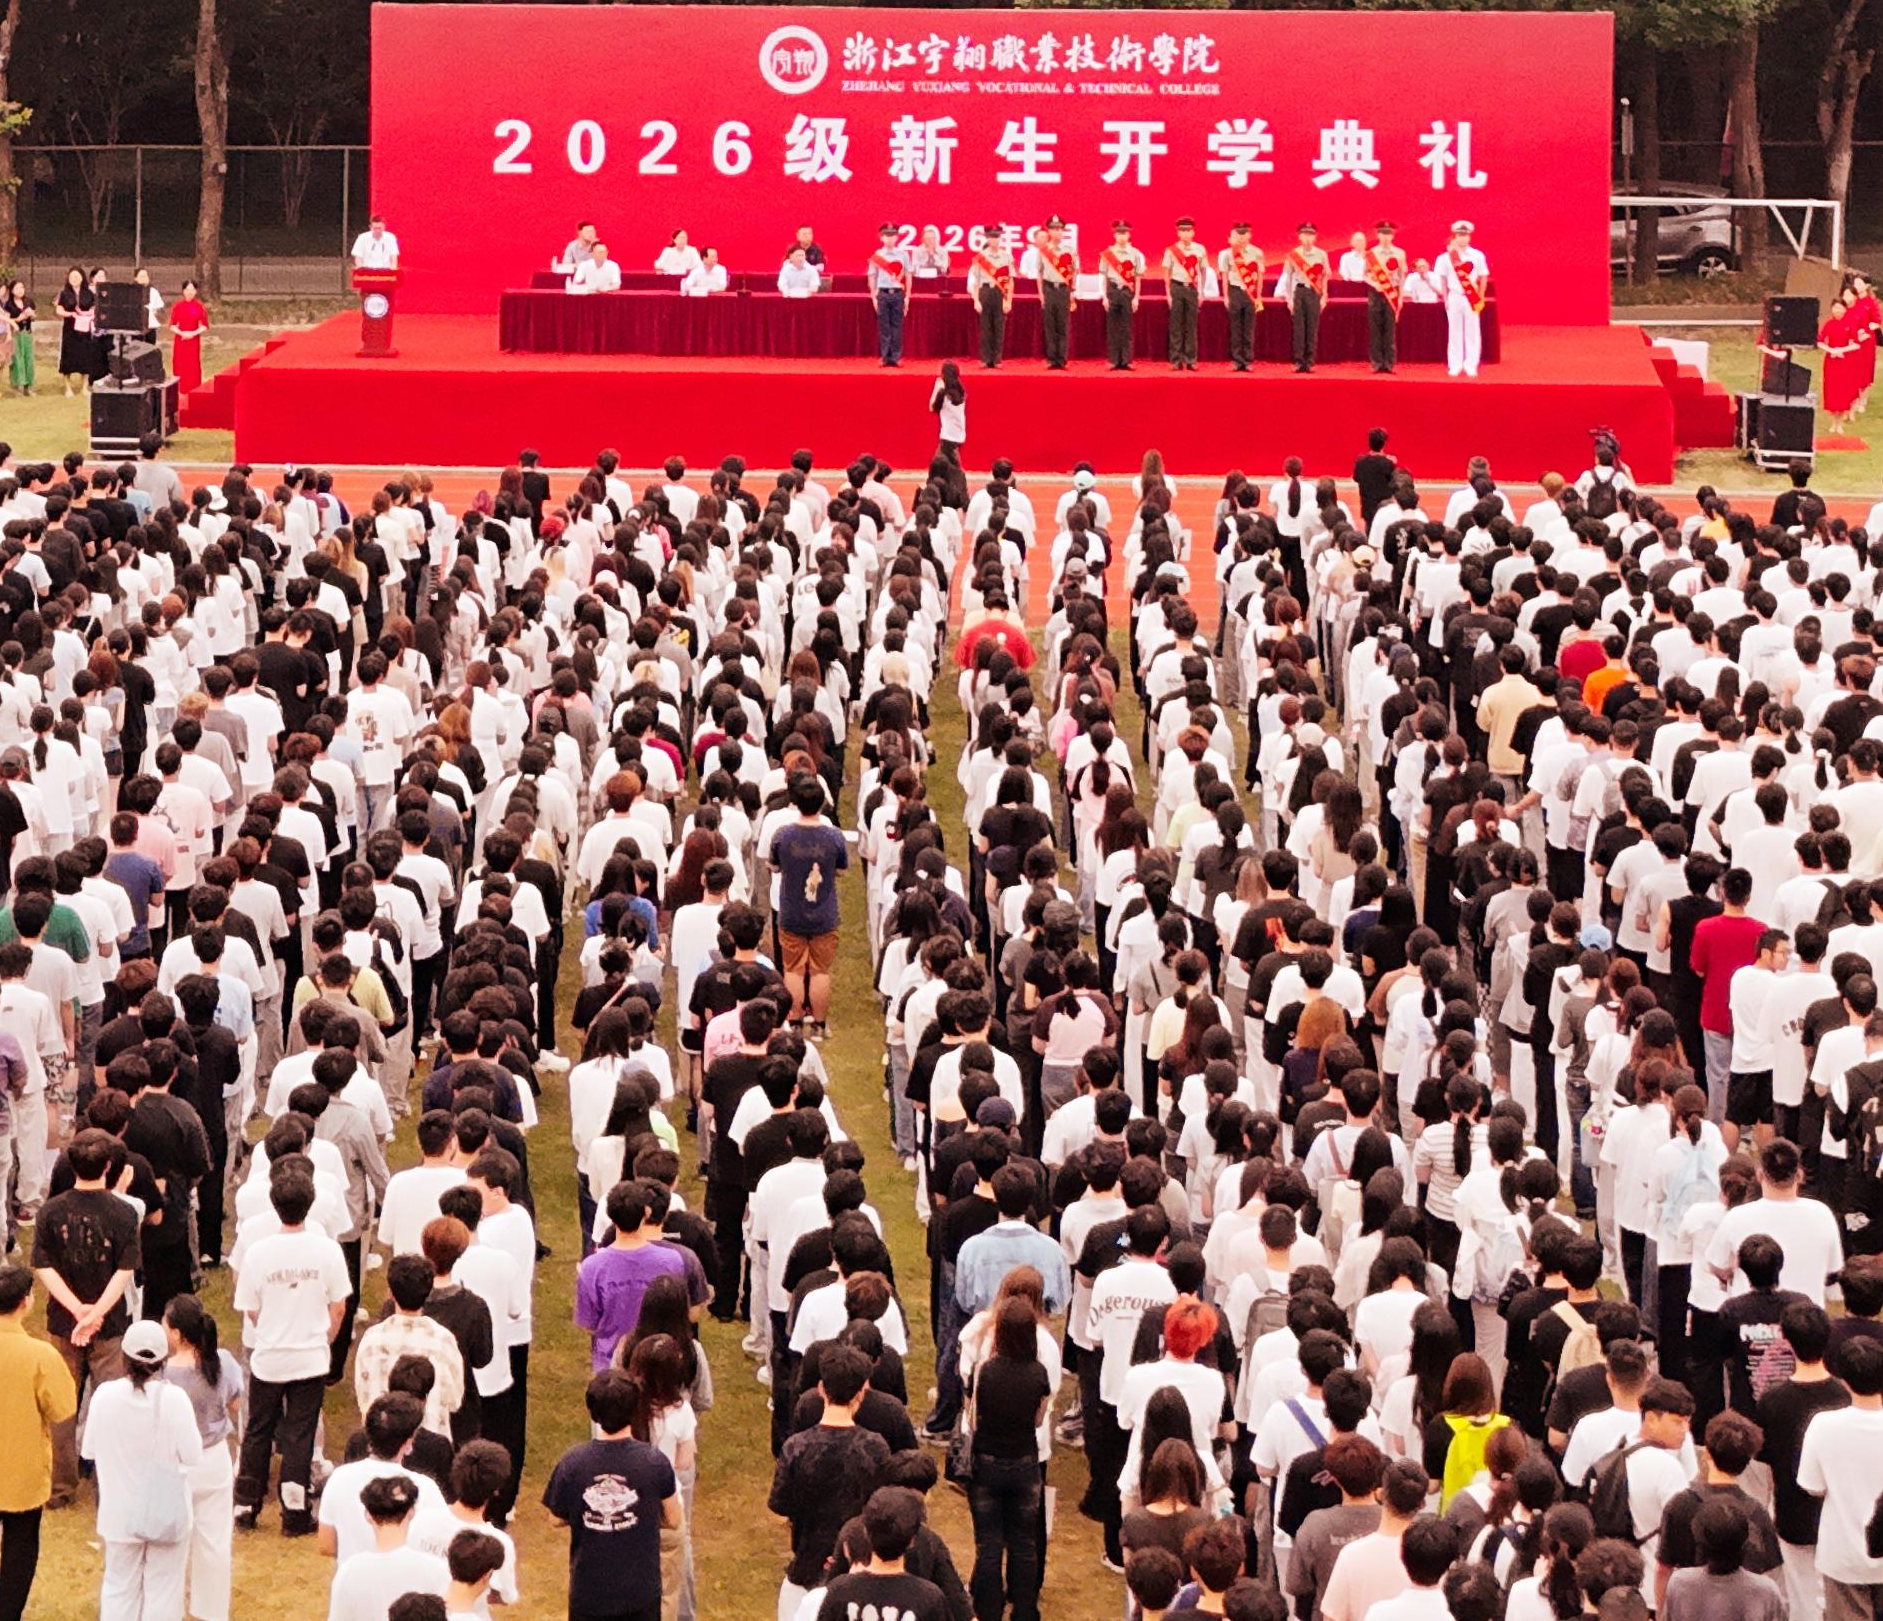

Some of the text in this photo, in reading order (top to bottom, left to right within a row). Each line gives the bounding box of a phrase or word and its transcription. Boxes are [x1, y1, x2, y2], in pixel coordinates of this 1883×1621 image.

[912, 80, 970, 93] YUXIANG
[975, 81, 1059, 93] VOCATIONAL
[1063, 82, 1075, 93] &
[1079, 82, 1153, 94] TECHNICAL
[1159, 82, 1220, 95] COLLEGE
[493, 114, 1489, 189] 2026级新生开学典礼
